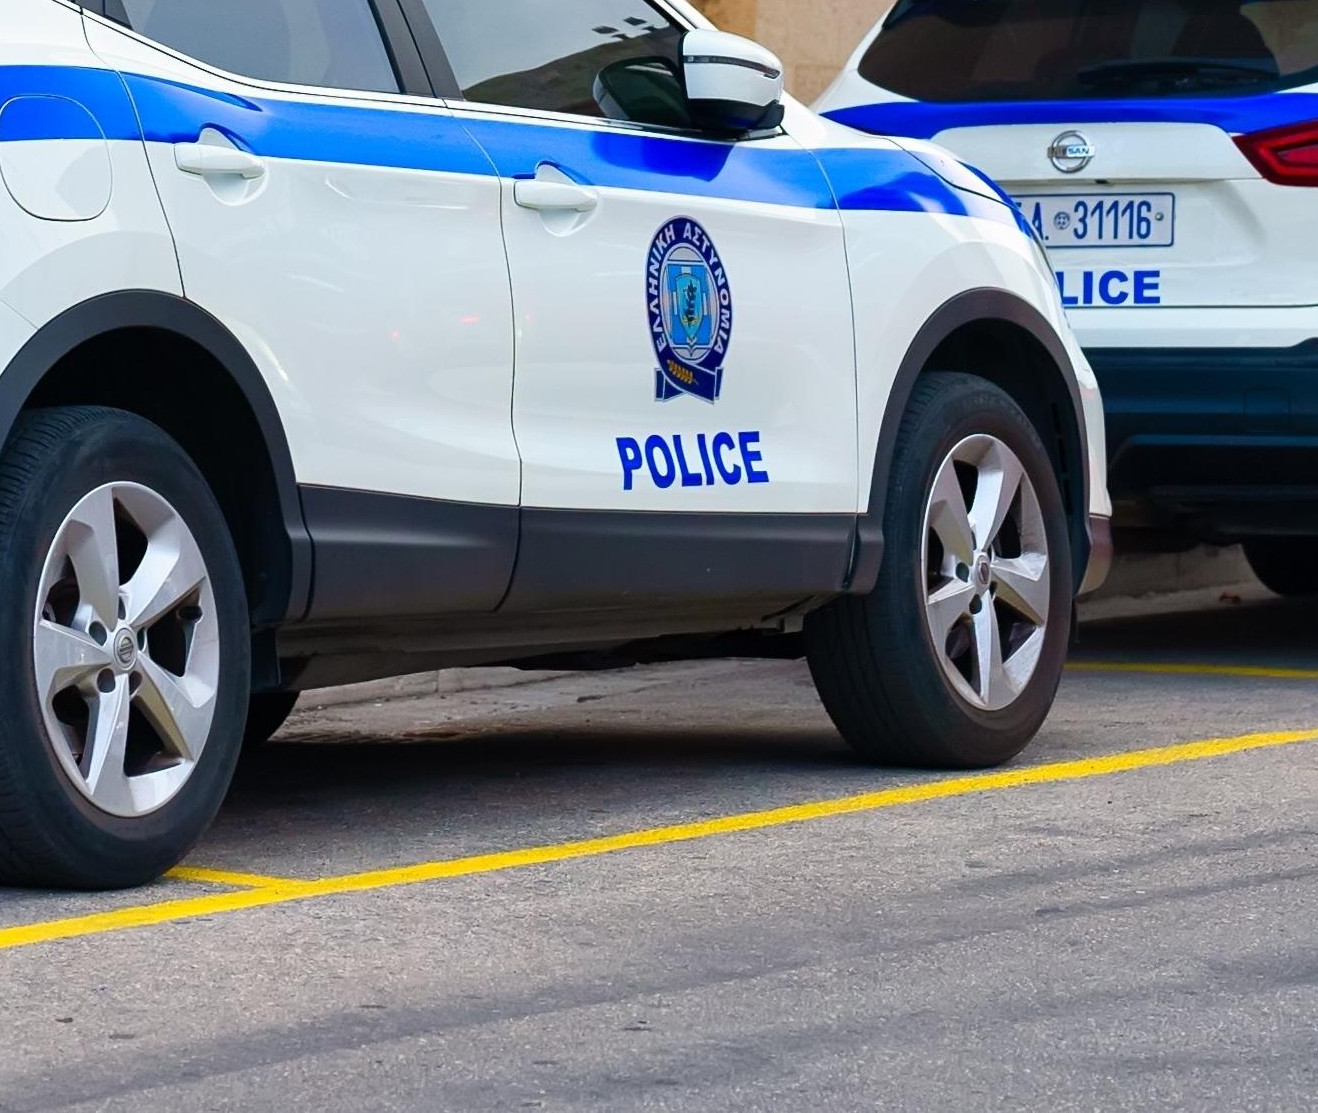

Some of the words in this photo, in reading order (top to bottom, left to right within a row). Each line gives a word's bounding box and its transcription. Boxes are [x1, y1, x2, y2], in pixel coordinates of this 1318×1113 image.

[1073, 200, 1152, 240] 31116
[648, 224, 676, 354] ΕΛΛΗΝΙΚΗ
[683, 222, 731, 355] ΑΣΤΥΝΟΜΙΑ
[1055, 270, 1161, 304] LICE
[616, 431, 770, 491] POLICE
